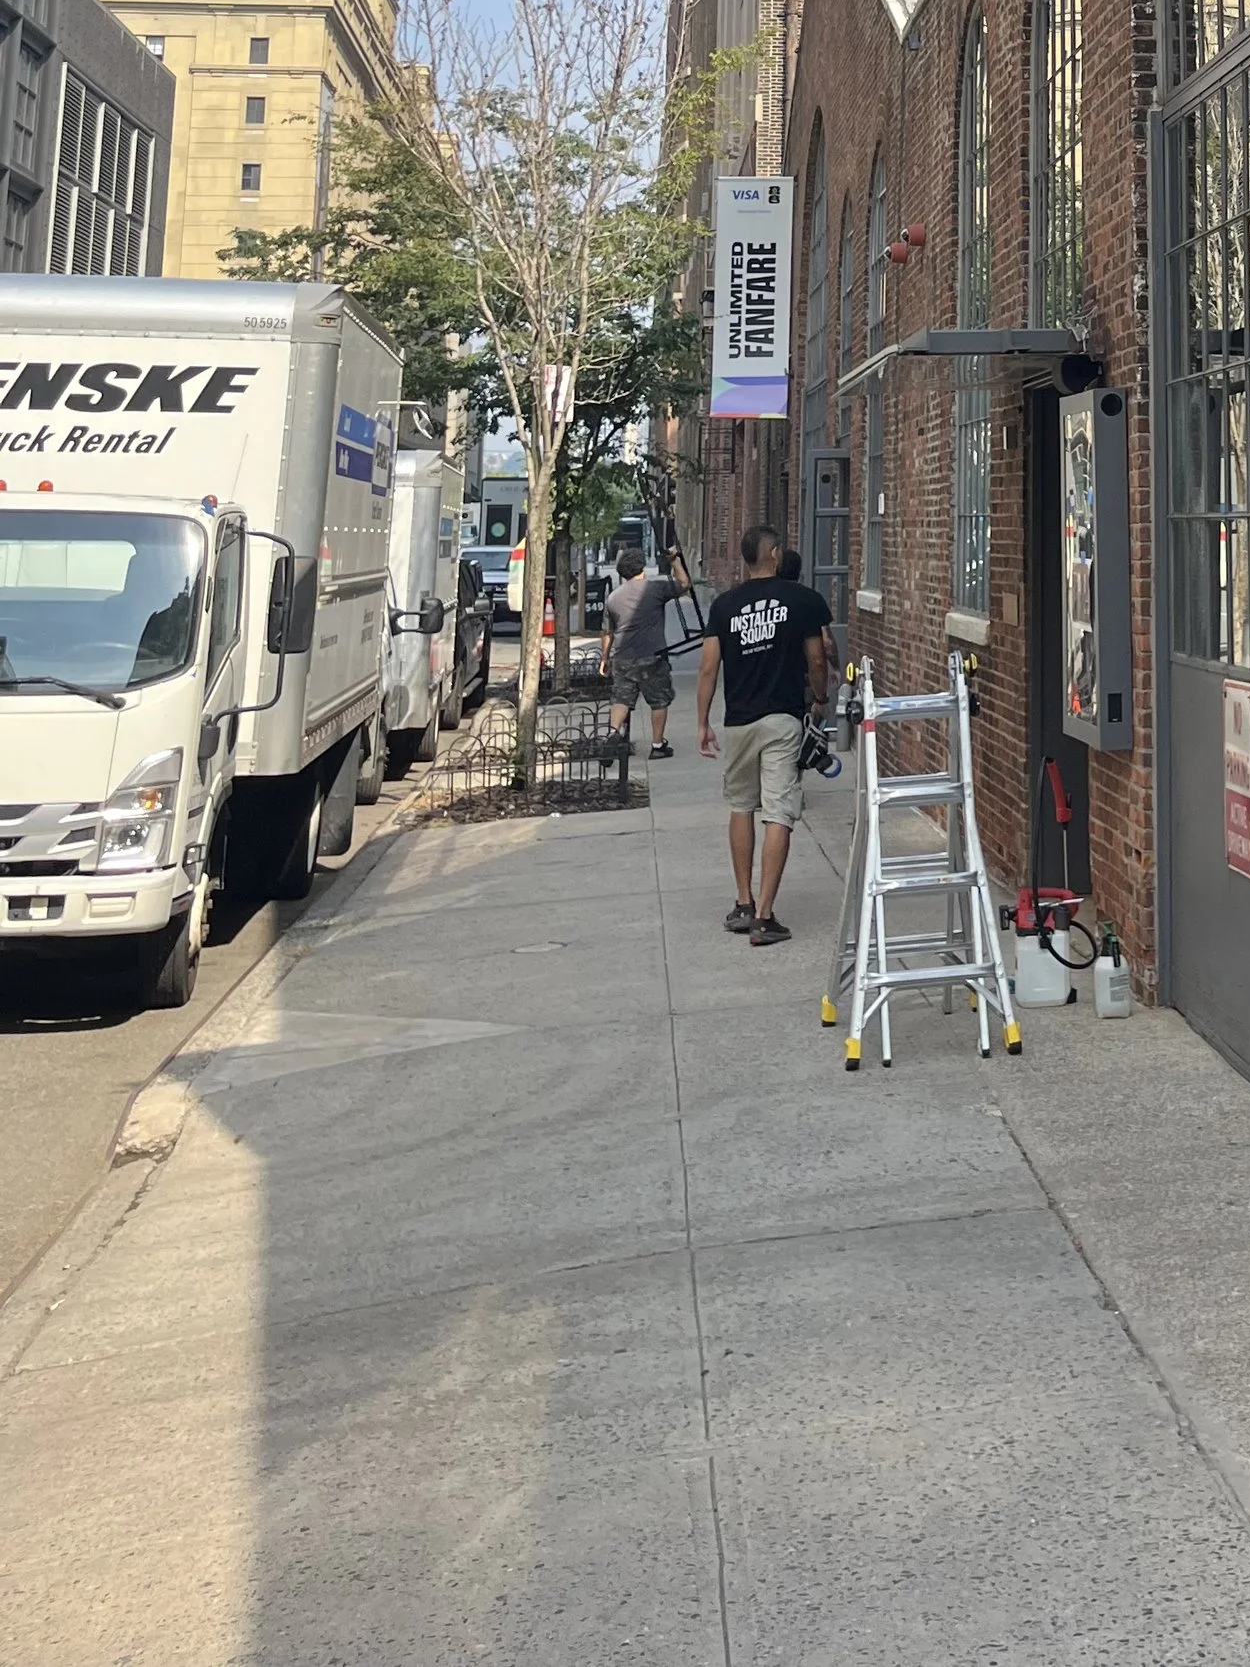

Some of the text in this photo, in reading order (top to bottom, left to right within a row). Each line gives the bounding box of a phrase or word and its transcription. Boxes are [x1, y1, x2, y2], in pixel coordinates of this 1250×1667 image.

[732, 189, 760, 200] VISA
[729, 241, 744, 359] UNLIMITED
[744, 242, 777, 358] FANFARE
[57, 425, 177, 454] Rental
[730, 606, 788, 633] INSTALLER
[740, 623, 776, 645] SQUAD
